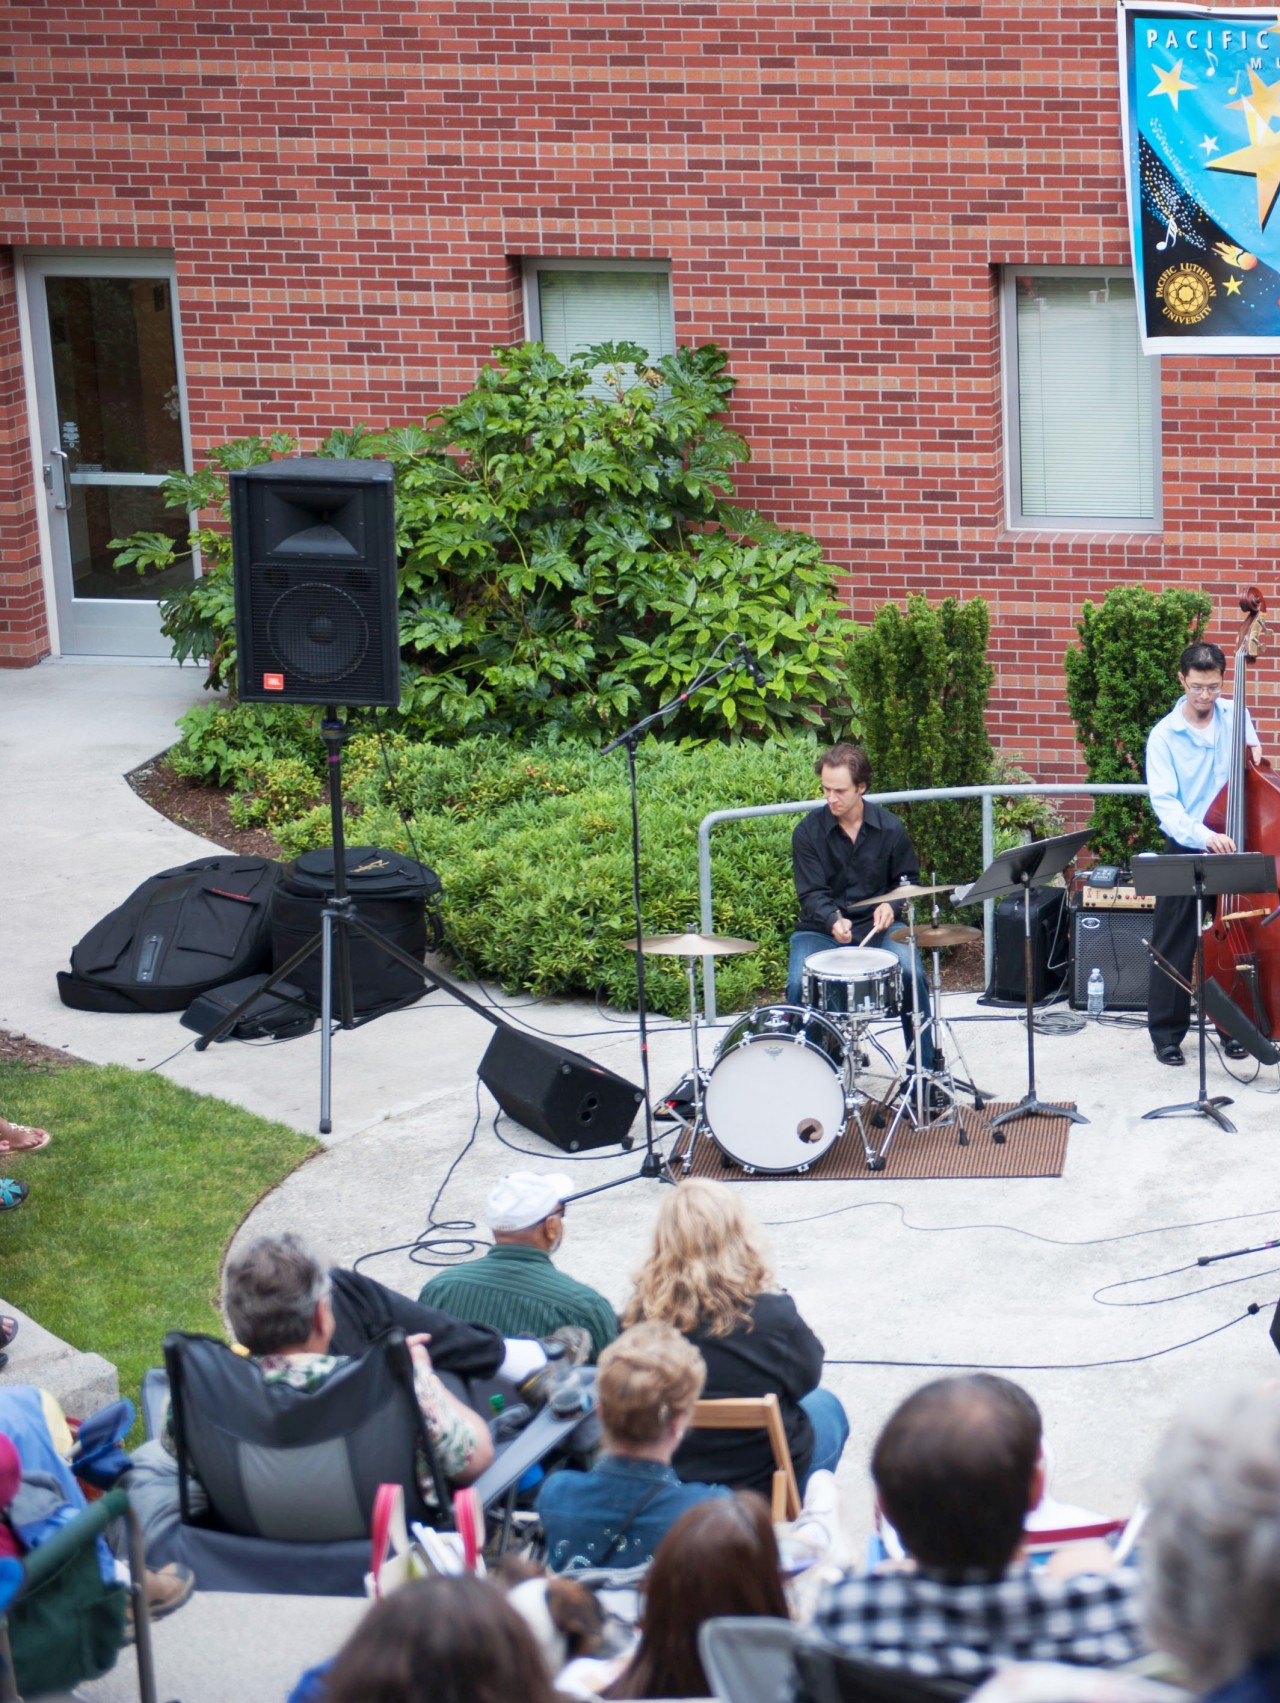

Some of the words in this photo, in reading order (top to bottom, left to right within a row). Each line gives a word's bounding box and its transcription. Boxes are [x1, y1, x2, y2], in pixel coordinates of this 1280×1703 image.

[1147, 29, 1269, 50] PACIFIC
[1155, 265, 1177, 298] PACIFIC
[1180, 262, 1217, 297] LUTHERAN
[1162, 304, 1212, 325] UNIVERSITY
